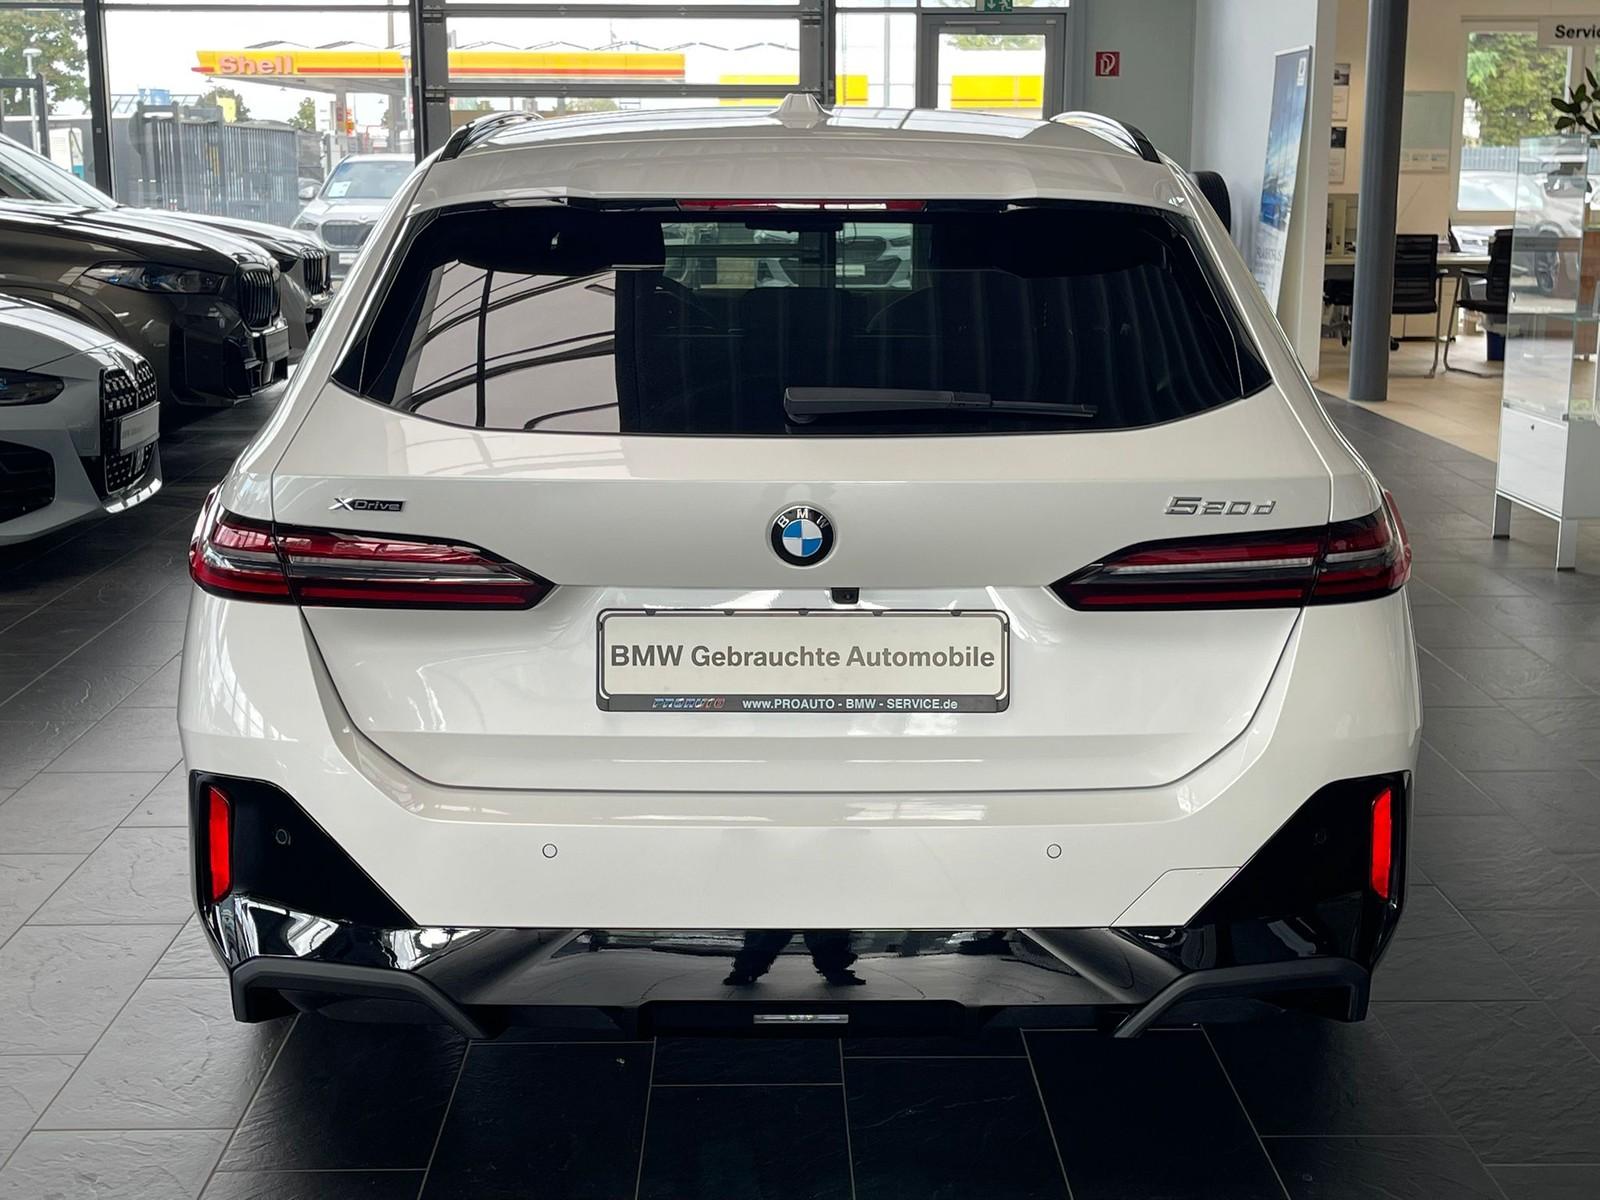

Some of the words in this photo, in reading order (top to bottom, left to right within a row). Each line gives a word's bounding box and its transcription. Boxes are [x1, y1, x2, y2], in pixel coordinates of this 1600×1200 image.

[220, 55, 293, 75] Shell
[1165, 496, 1276, 516] 520d
[777, 507, 830, 529] BMW
[611, 644, 684, 667] BMW
[691, 645, 841, 667] Gebrauchte
[846, 645, 995, 668] Automobile
[742, 698, 835, 709] www.PROAUTO
[846, 698, 877, 709] BMW
[886, 698, 959, 709] SERVICE.de
